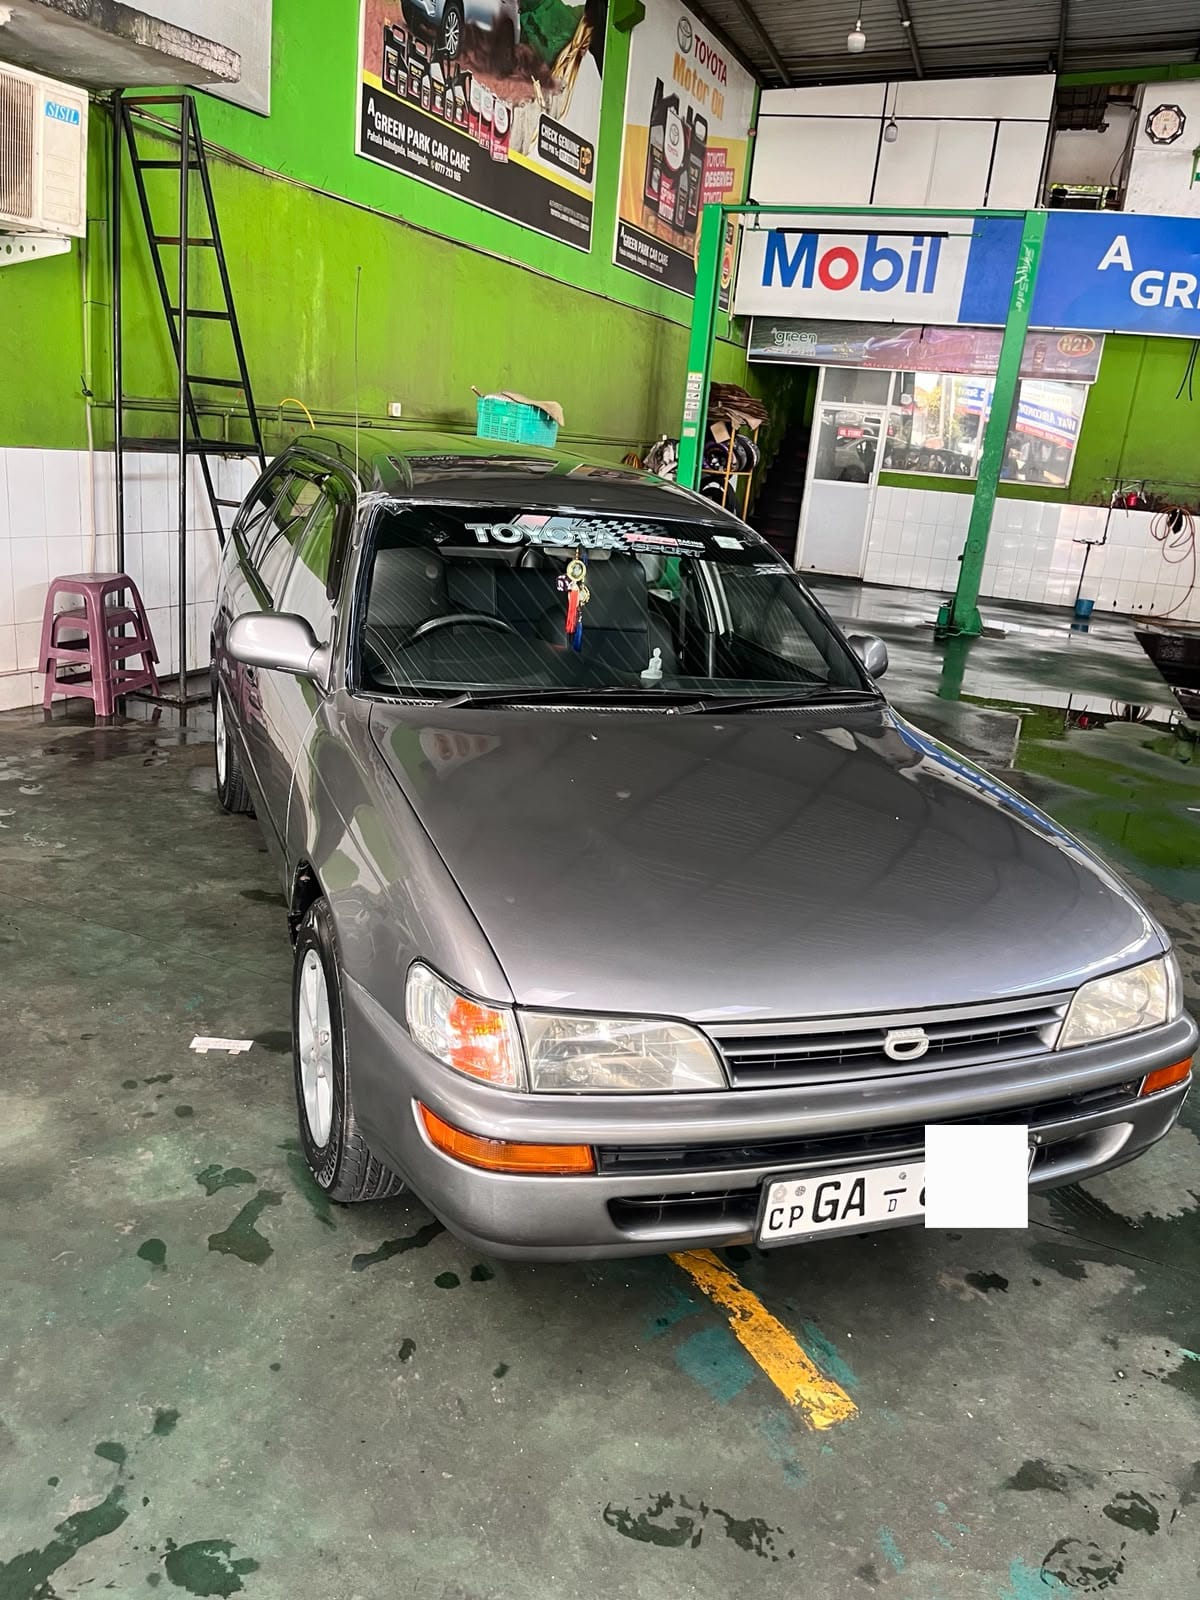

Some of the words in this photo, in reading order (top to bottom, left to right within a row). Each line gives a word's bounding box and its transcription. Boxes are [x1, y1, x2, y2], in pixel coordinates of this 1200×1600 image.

[694, 34, 728, 87] TOYOTA
[673, 51, 709, 106] Motor
[48, 102, 77, 124] SISIL
[367, 97, 375, 116] A
[374, 111, 406, 142] GREEN
[406, 126, 431, 154] PARK
[431, 139, 449, 164] CAR
[449, 148, 471, 174] CARE
[541, 123, 559, 145] CHECK
[558, 133, 580, 158] GENUINE
[706, 152, 727, 168] TOYOTA
[704, 170, 734, 189] DESERVES
[623, 234, 639, 253] GREEN
[649, 247, 659, 263] CAR
[658, 251, 669, 267] CARE
[761, 230, 943, 294] Mobil
[1096, 235, 1134, 272] A
[1130, 269, 1200, 310] GR
[774, 330, 818, 346] green
[464, 522, 623, 550] TOYOTA
[769, 1206, 804, 1231] CP
[811, 1177, 866, 1224] GA
